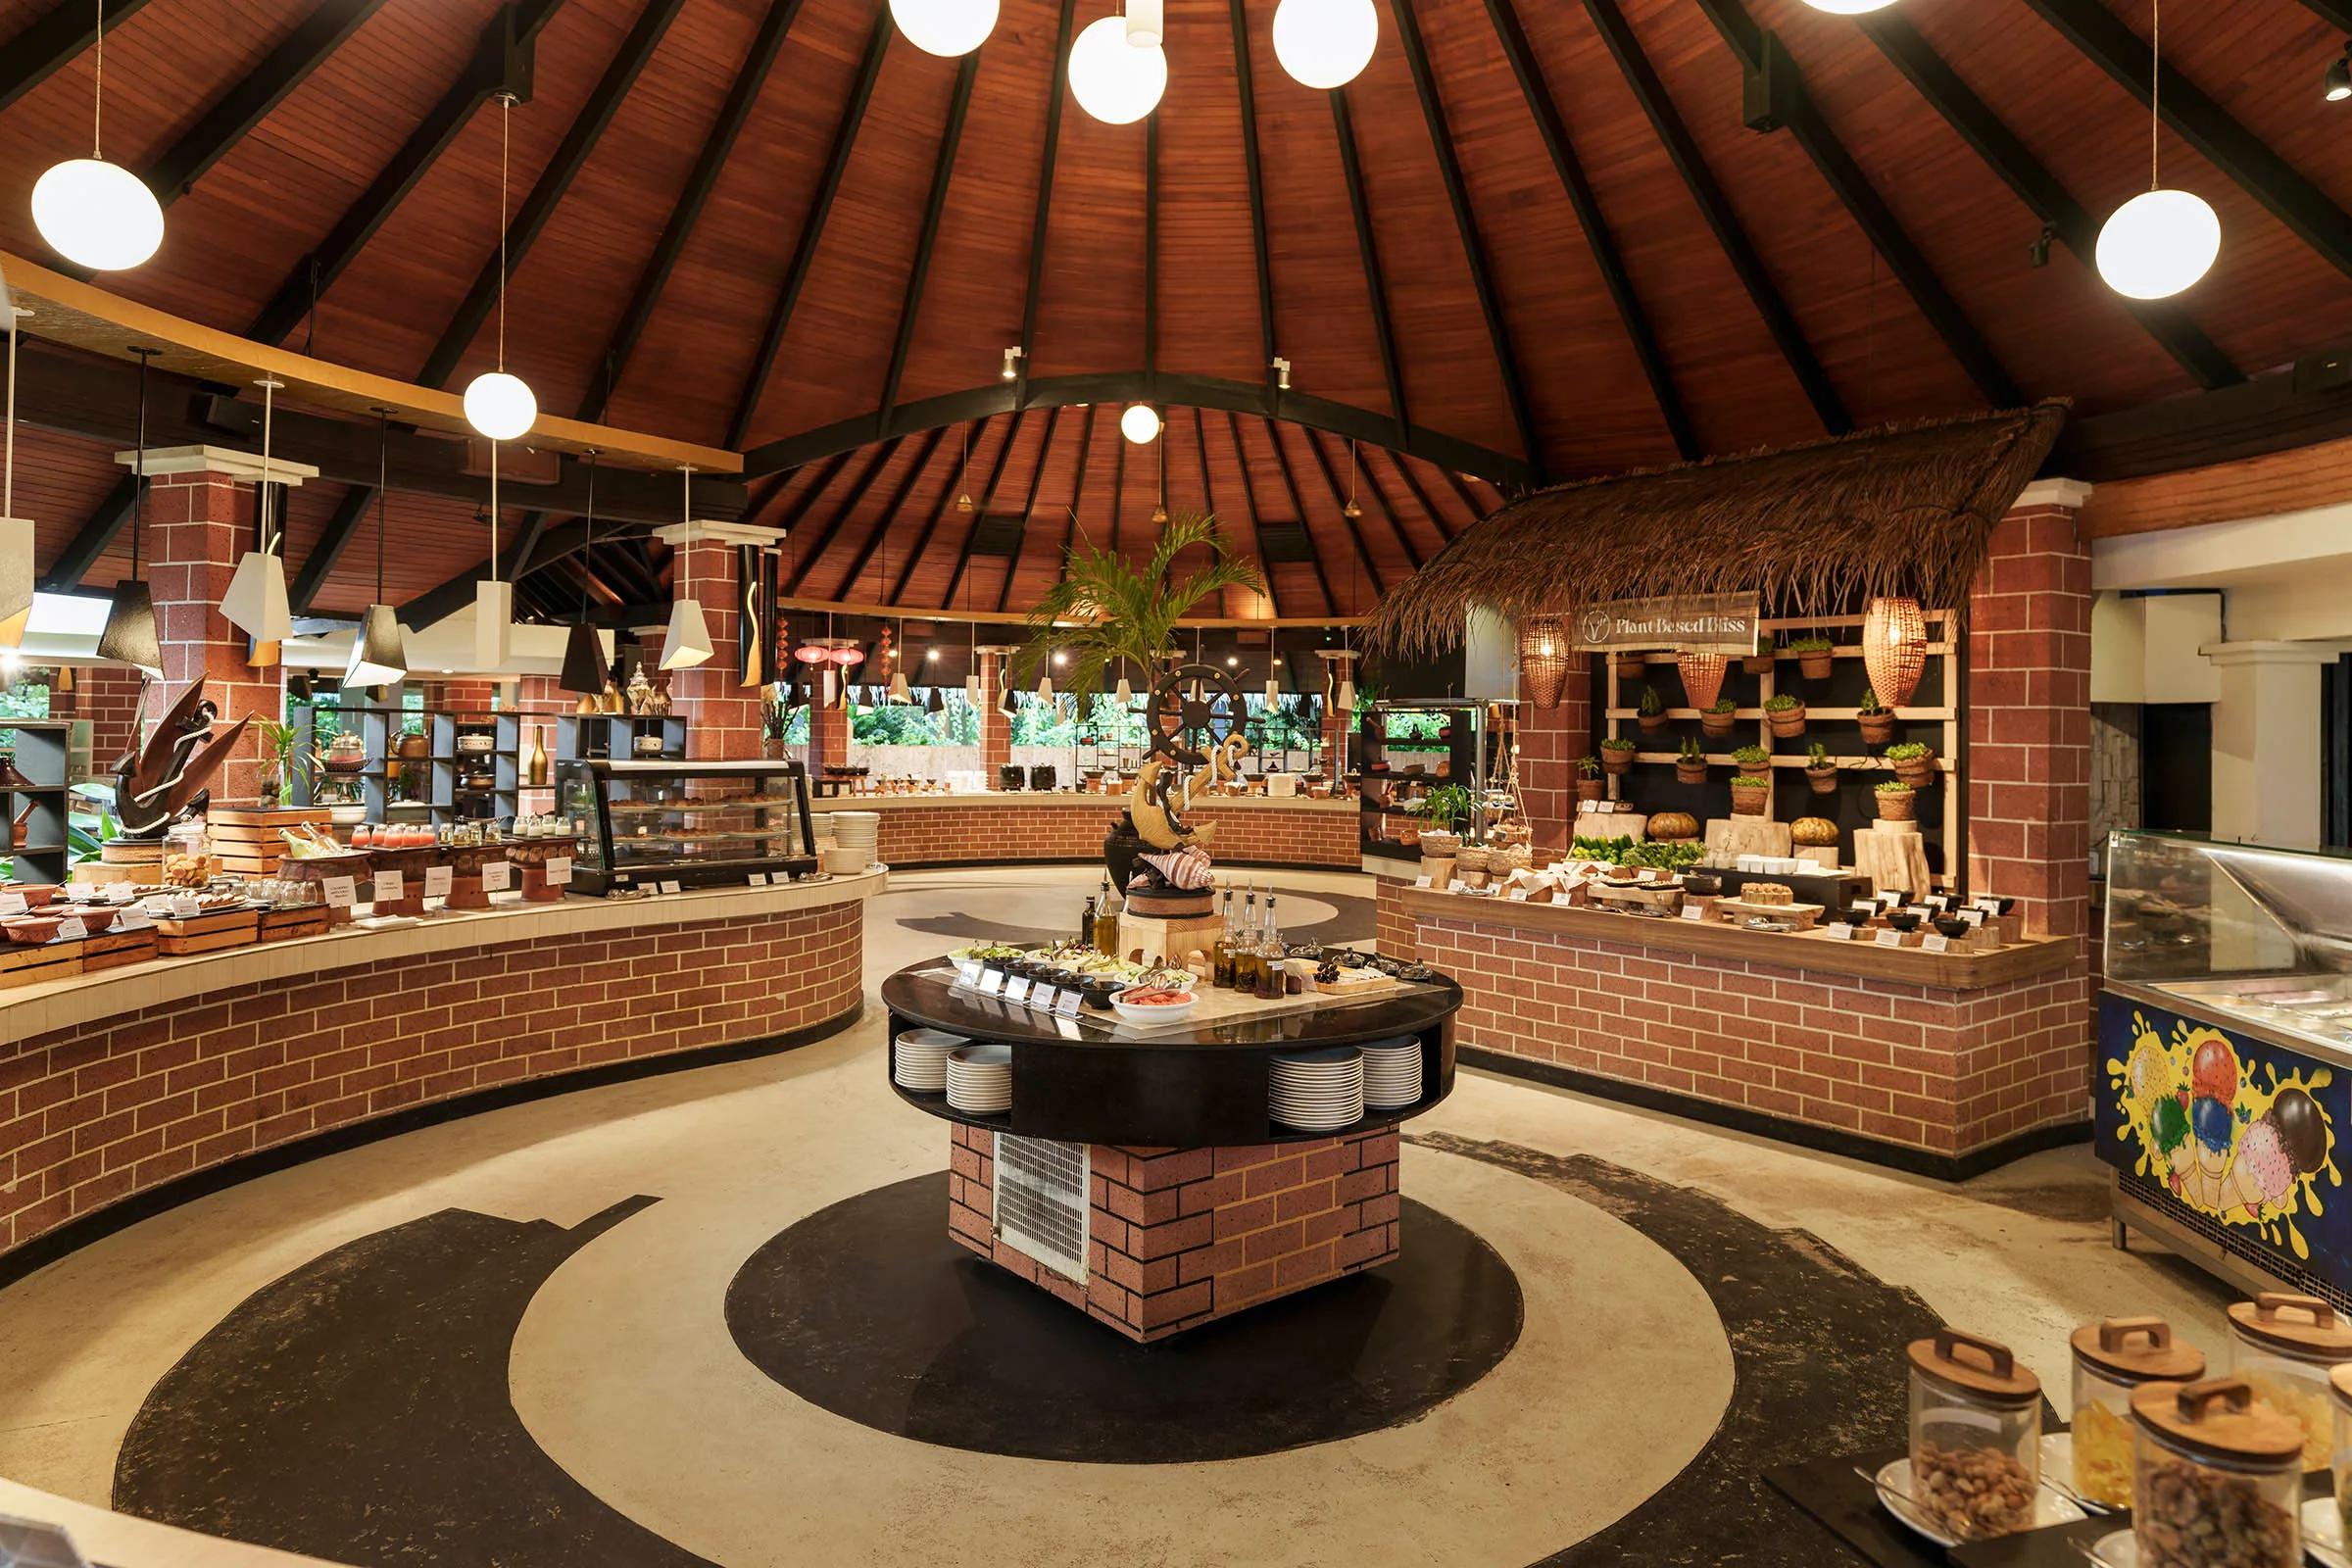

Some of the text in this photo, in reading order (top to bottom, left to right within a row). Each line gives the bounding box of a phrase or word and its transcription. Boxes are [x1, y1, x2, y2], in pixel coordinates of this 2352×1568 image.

[1616, 616, 1745, 634] Plant Based Bliss
